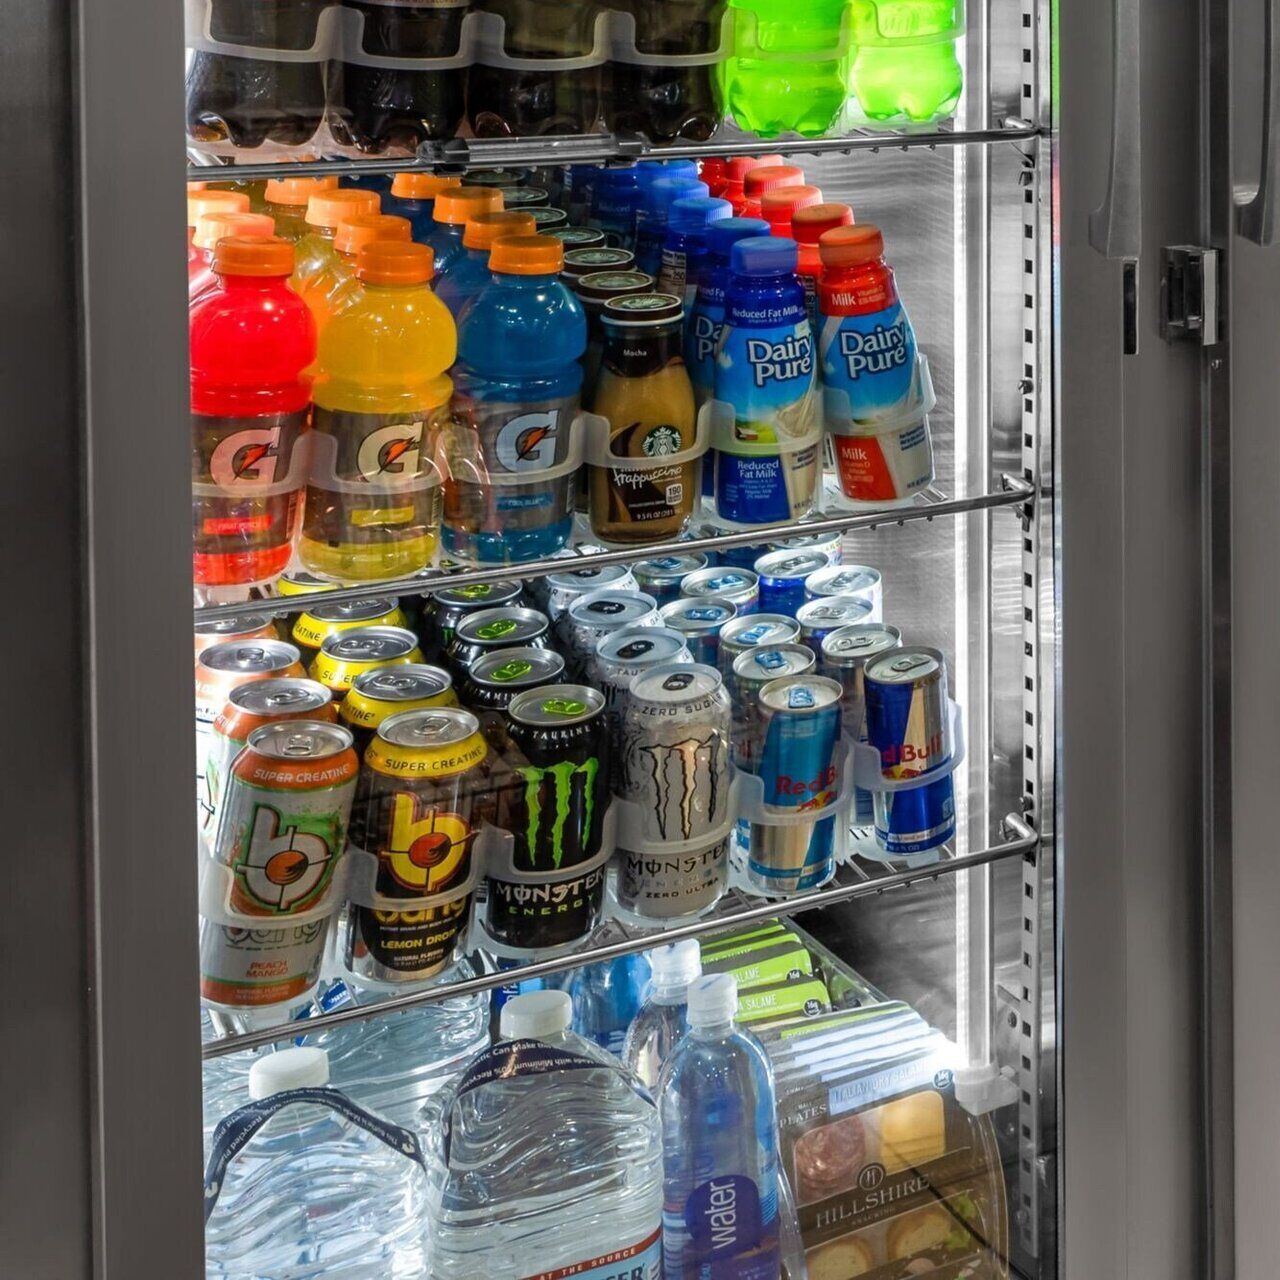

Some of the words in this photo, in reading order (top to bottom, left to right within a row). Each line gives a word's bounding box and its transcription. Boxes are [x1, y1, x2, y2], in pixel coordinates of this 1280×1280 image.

[831, 294, 856, 306] Milk
[733, 308, 766, 318] Reduced
[768, 309, 781, 317] Fat
[783, 305, 798, 315] Milk
[841, 323, 905, 354] Dairy
[623, 348, 648, 357] Mocha
[749, 336, 812, 363] Dairy
[756, 357, 811, 386] Pure
[848, 347, 905, 378] Pure
[496, 410, 558, 472] G
[210, 426, 282, 487] G
[841, 448, 868, 460] Milk
[738, 460, 779, 470] Reduced
[740, 470, 754, 478] Fat
[756, 470, 777, 478] Milk
[532, 727, 591, 740] TAURINE
[901, 738, 943, 762] Bull
[254, 769, 293, 783] SUPER
[296, 764, 348, 783] CREATINE
[776, 773, 821, 795] Red
[686, 878, 719, 894] ULTRA
[508, 893, 595, 916] ENERGY
[381, 939, 422, 949] LEMON
[246, 969, 288, 977] MANGO
[251, 960, 288, 969] PEACH
[748, 995, 777, 1011] SALAME
[780, 1104, 827, 1129] PLATES
[816, 1174, 930, 1229] HILLSHIRE
[705, 1179, 736, 1250] water
[562, 1264, 583, 1276] THE
[592, 1247, 636, 1266] SOURCE
